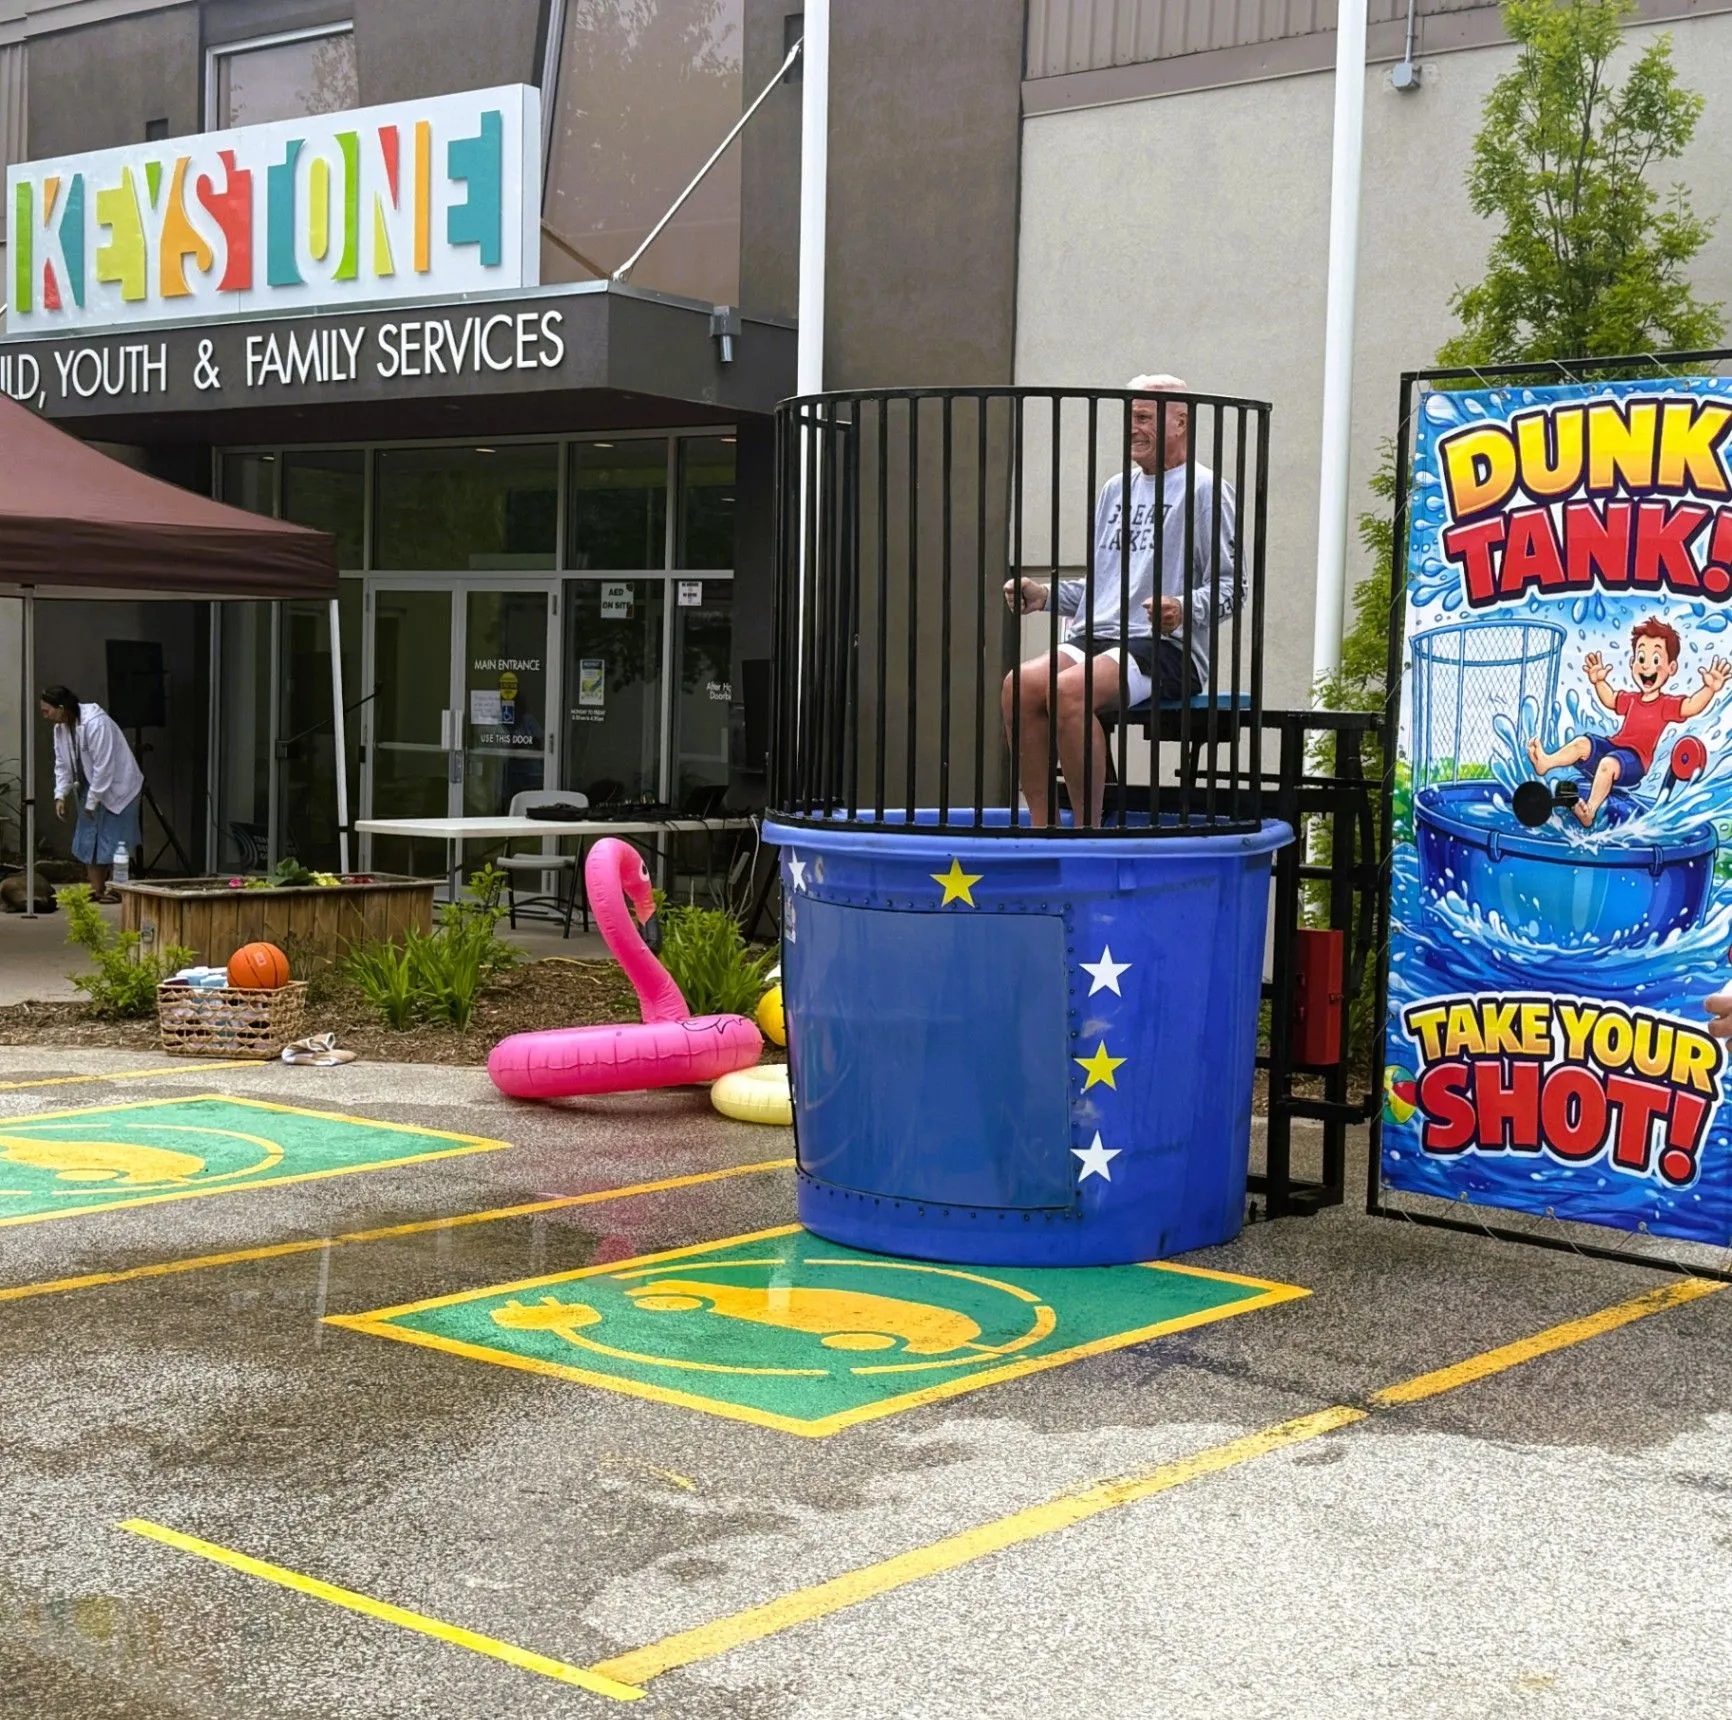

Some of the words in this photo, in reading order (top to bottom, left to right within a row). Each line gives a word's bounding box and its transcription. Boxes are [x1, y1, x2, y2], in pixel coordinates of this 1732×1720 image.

[15, 109, 502, 314] KEYSTONE
[54, 342, 168, 399] YOUTH
[193, 338, 222, 391] &
[246, 325, 366, 387] FAMILY
[376, 309, 566, 379] SERVICES
[1442, 399, 1732, 519] DUNK
[602, 600, 614, 610] ON
[608, 587, 625, 597] AED
[474, 658, 497, 671] MAIN
[498, 658, 541, 671] ENTRANCE
[480, 733, 494, 743] USE
[495, 734, 511, 744] THIS
[512, 735, 534, 745] DOOR
[1407, 1001, 1551, 1062] TAKE
[1558, 1003, 1719, 1095] YOUR
[1419, 1059, 1708, 1181] SHOT!
